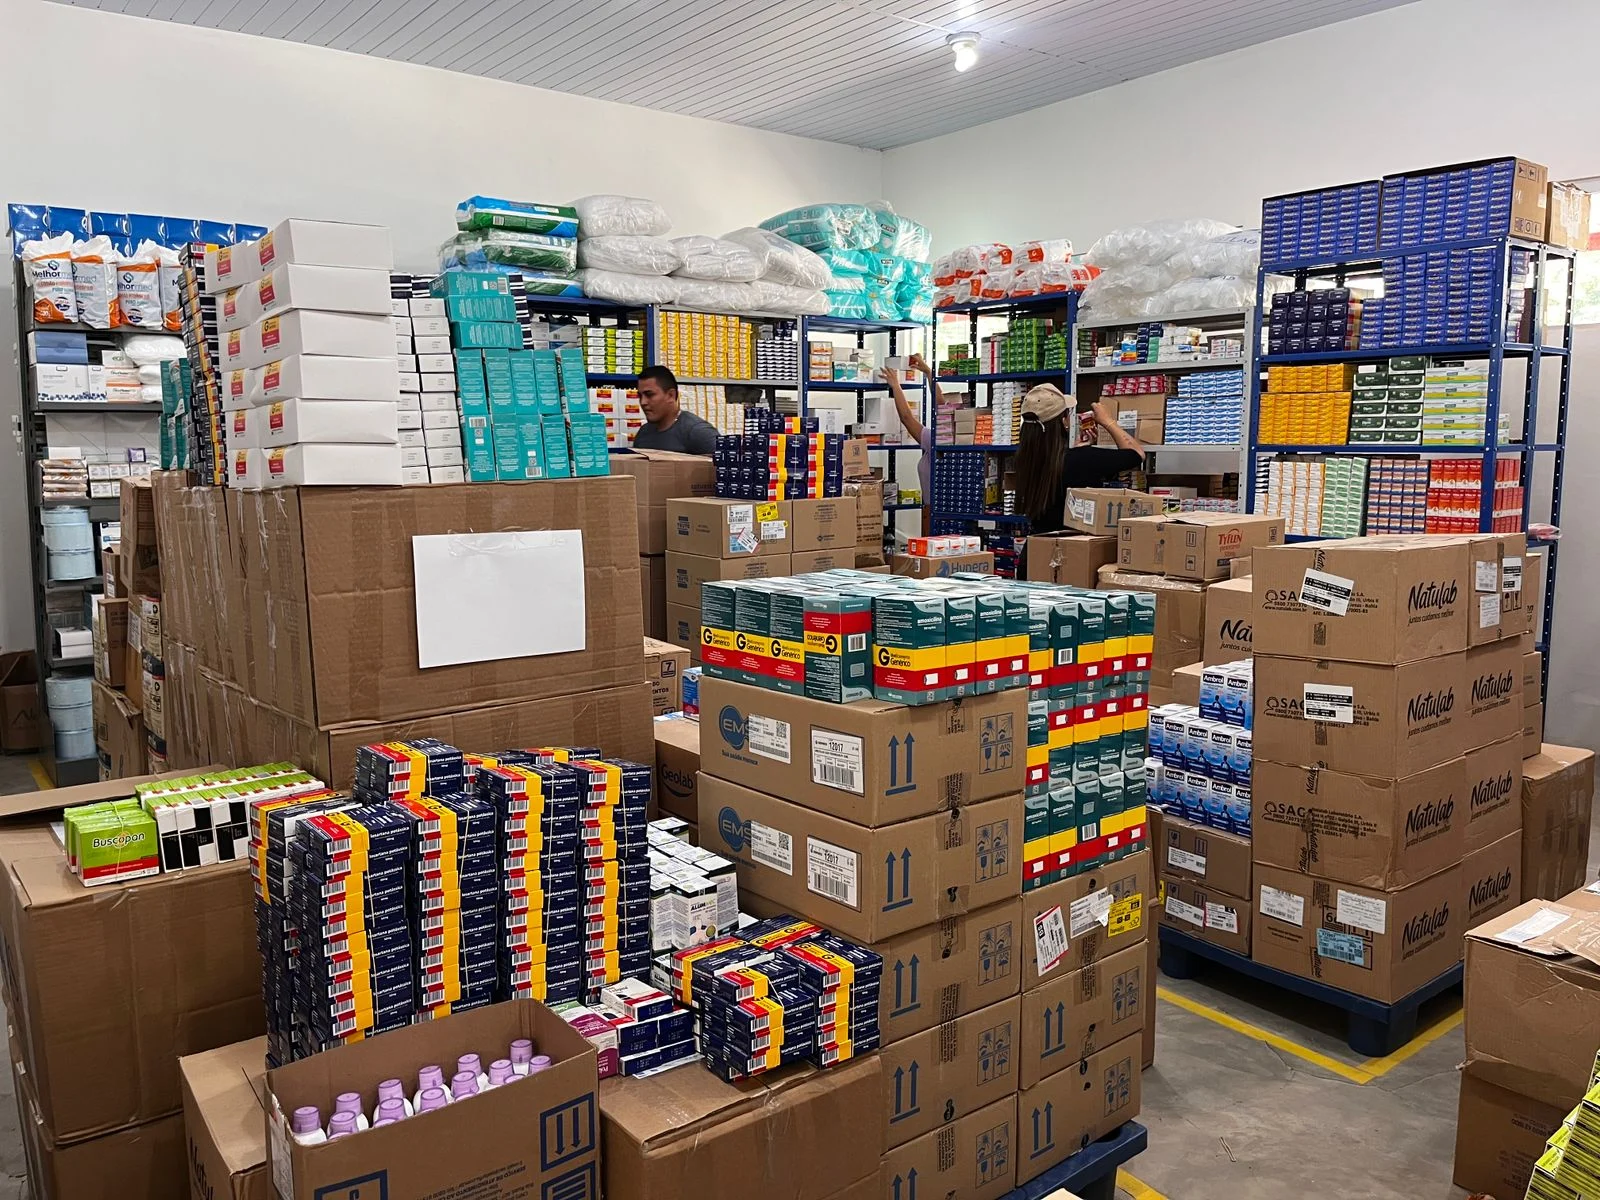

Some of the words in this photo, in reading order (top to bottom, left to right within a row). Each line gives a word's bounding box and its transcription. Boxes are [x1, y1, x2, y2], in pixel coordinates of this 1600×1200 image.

[951, 560, 989, 574] Hypera
[1280, 591, 1300, 601] SA
[1408, 580, 1457, 614] Natulab
[980, 609, 1002, 617] amoxicilina
[1006, 607, 1027, 615] amoxicilina
[918, 616, 942, 625] amoxicilina
[1408, 615, 1421, 626] juntos
[704, 628, 713, 644] G
[736, 633, 746, 650] G
[771, 640, 781, 657] G
[826, 635, 838, 653] G
[1220, 642, 1240, 650] juntos
[878, 648, 890, 666] G
[665, 662, 672, 670] 7
[1204, 674, 1224, 684] Ambrol
[1228, 679, 1248, 688] Ambrol
[1472, 670, 1512, 705] Natulab
[1407, 687, 1454, 726] Natulab
[1166, 724, 1184, 732] Ambrol
[1189, 729, 1208, 737] Ambrol
[1212, 734, 1231, 743] Ambrol
[829, 742, 844, 752] 12017
[661, 763, 693, 789] Geolab
[1166, 770, 1184, 779] Ambrol
[1188, 777, 1206, 786] Ambrol
[1212, 784, 1232, 793] Ambrol
[1470, 770, 1512, 809] Natulab
[1278, 804, 1306, 818] SAC
[1405, 794, 1454, 838] Natulab
[722, 820, 751, 838] EMS
[93, 831, 145, 848] Buscopan
[824, 853, 839, 864] 12017
[1469, 866, 1511, 911] Natulab
[1402, 901, 1449, 950] Natulab
